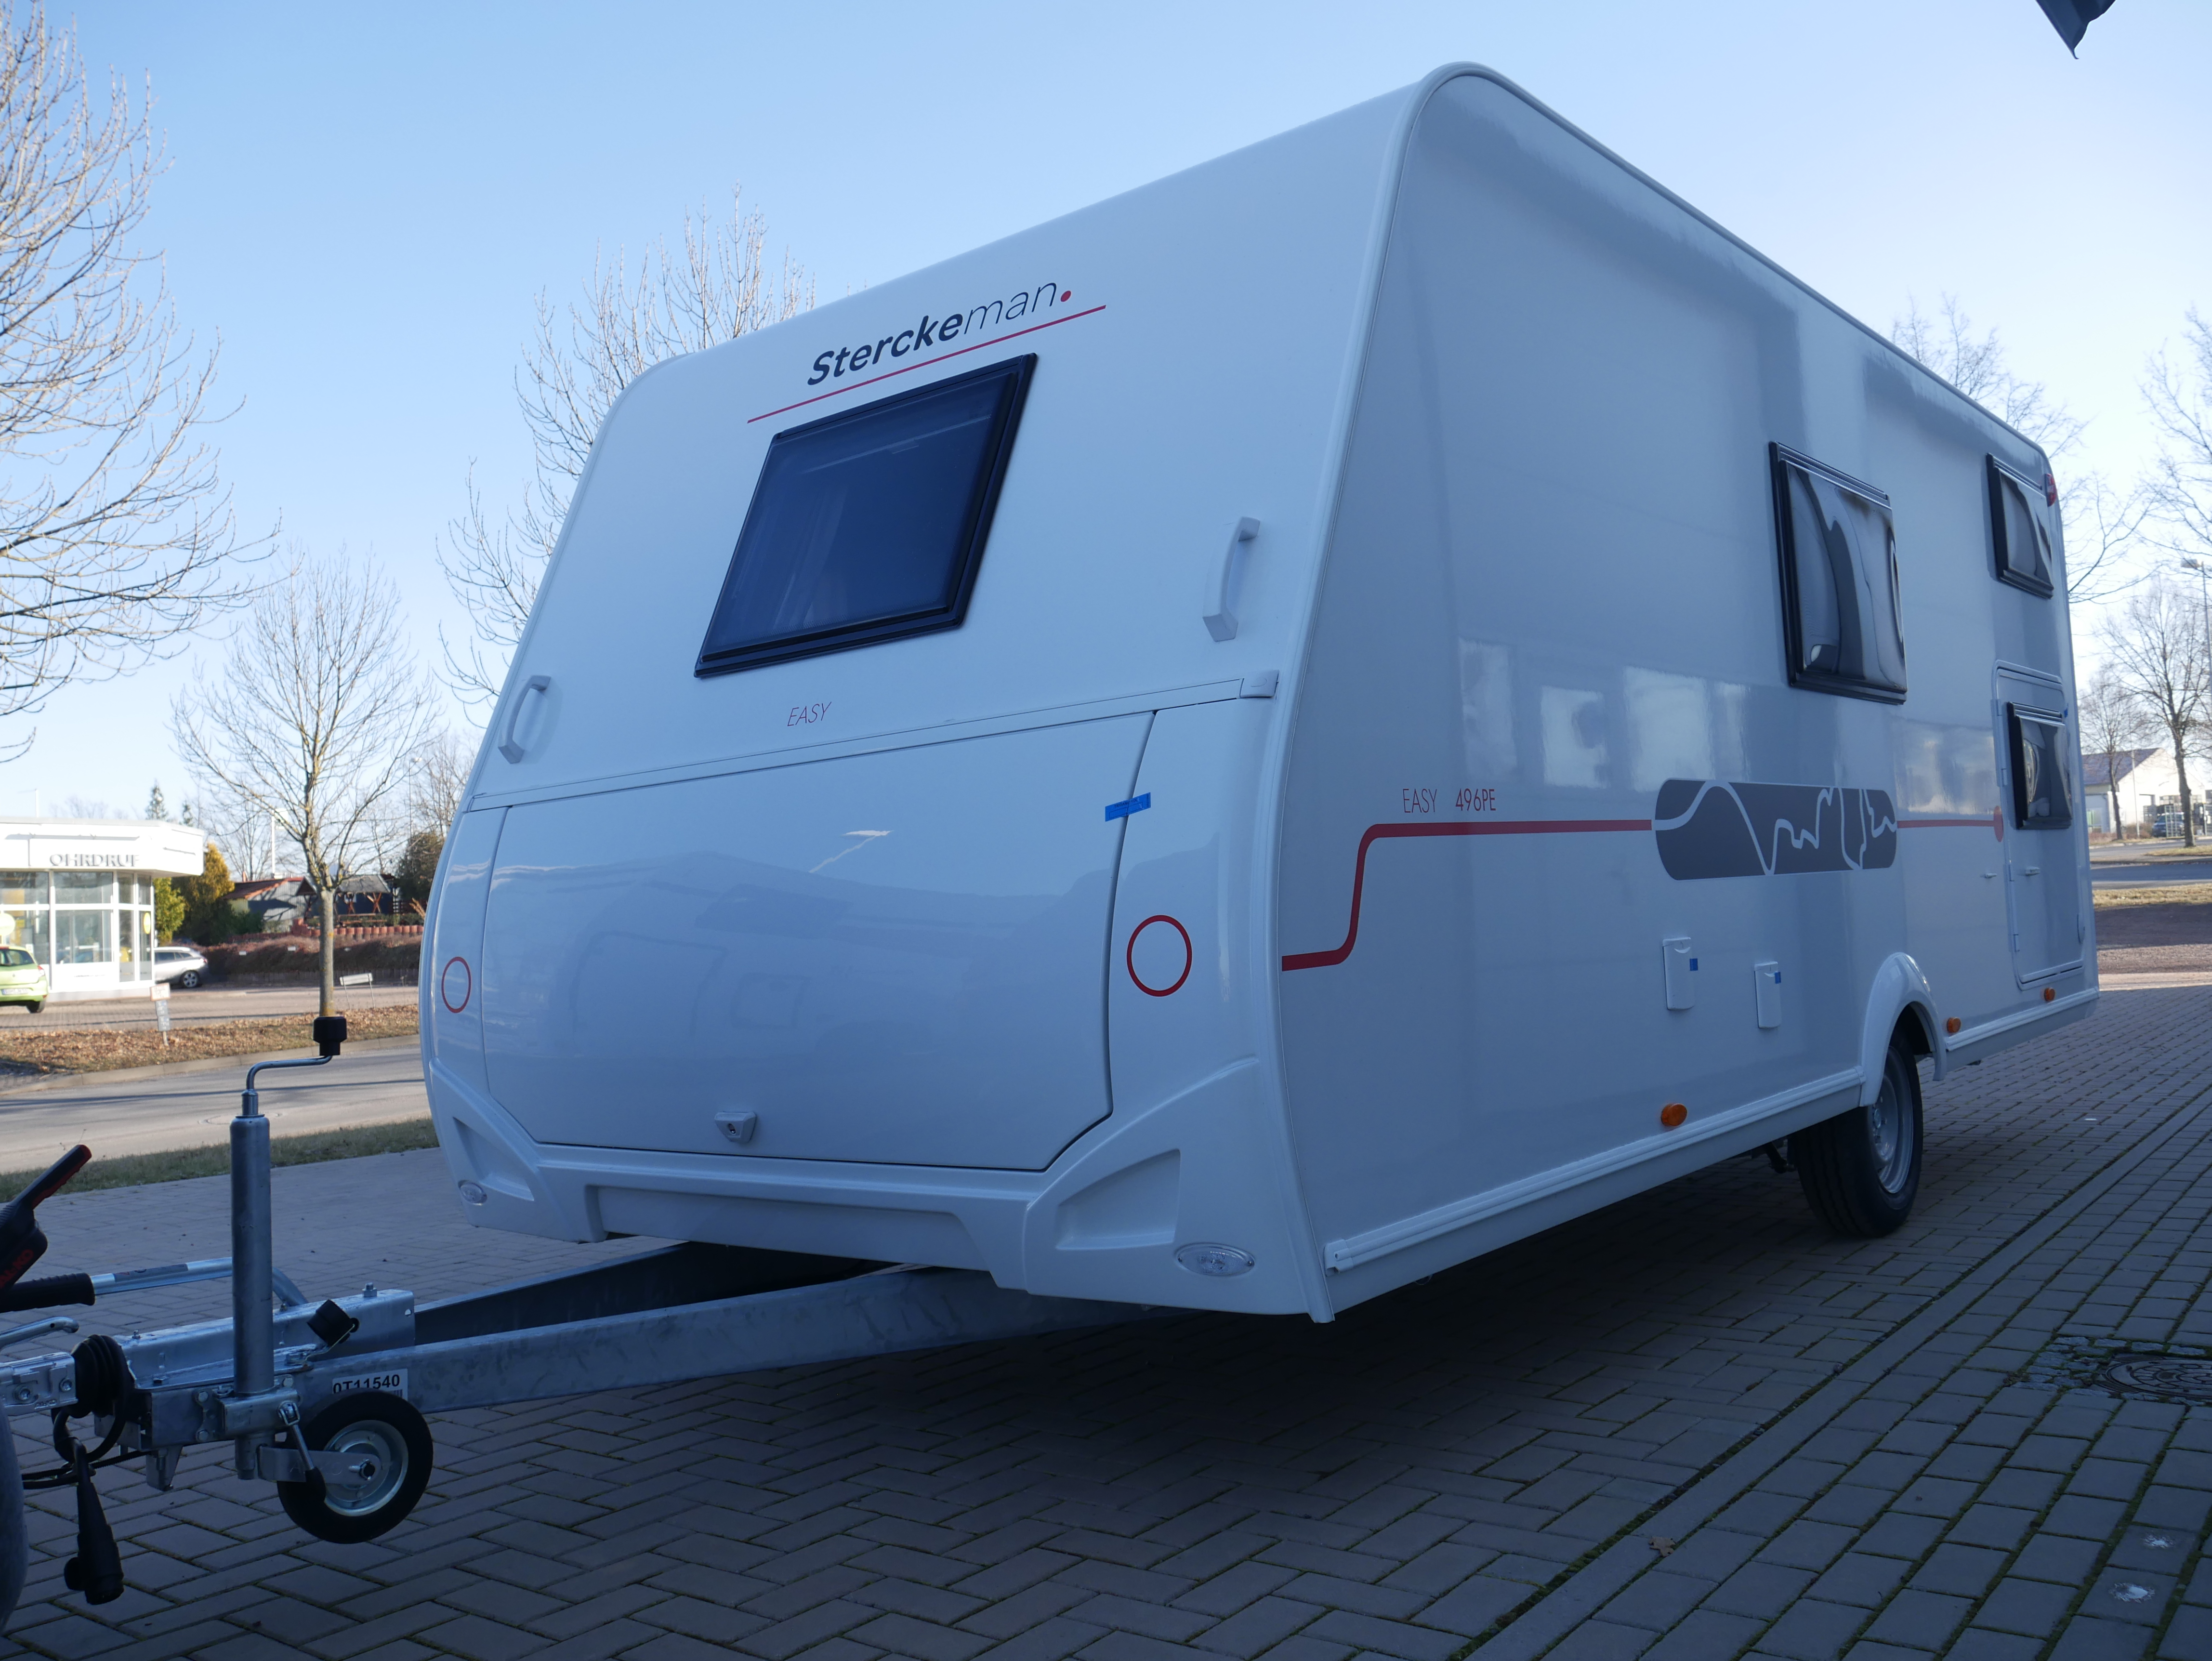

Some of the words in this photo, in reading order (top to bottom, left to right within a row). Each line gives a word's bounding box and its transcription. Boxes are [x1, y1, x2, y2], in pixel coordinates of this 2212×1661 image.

[787, 701, 832, 726] EASY
[1403, 788, 1437, 813] EASY
[1455, 788, 1496, 811] 496PE
[50, 854, 140, 867] OHRDRUF
